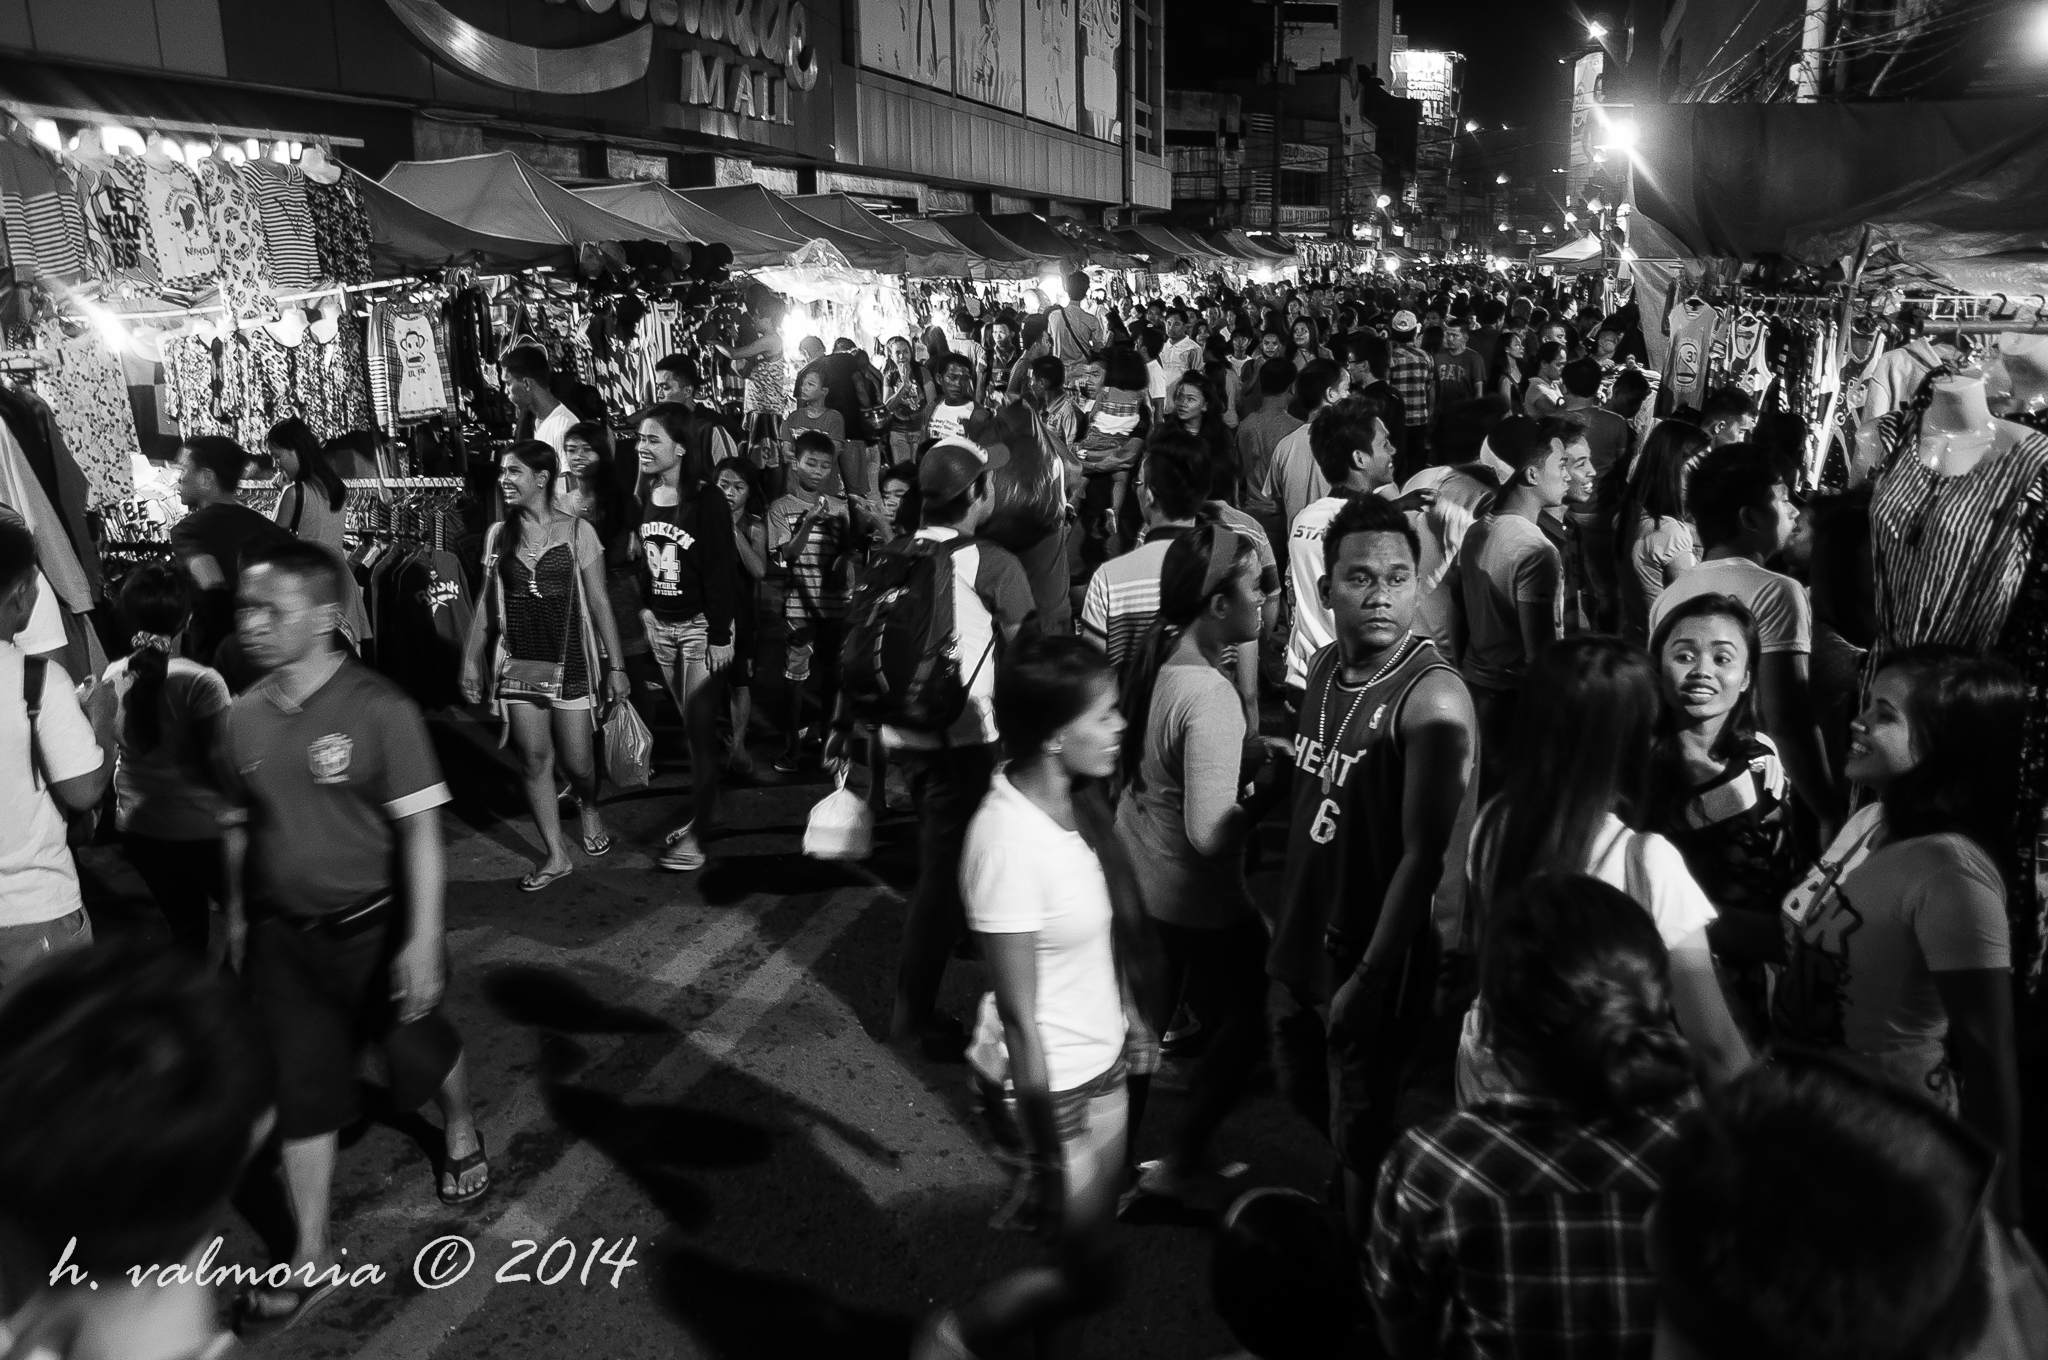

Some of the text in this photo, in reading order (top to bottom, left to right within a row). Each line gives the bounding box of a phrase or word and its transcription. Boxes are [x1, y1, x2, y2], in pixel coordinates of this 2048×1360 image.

[680, 50, 795, 126] MALL
[1439, 363, 1466, 382] GAP
[123, 501, 149, 521] BE
[1294, 732, 1367, 787] HEAT
[1309, 798, 1341, 844] 6
